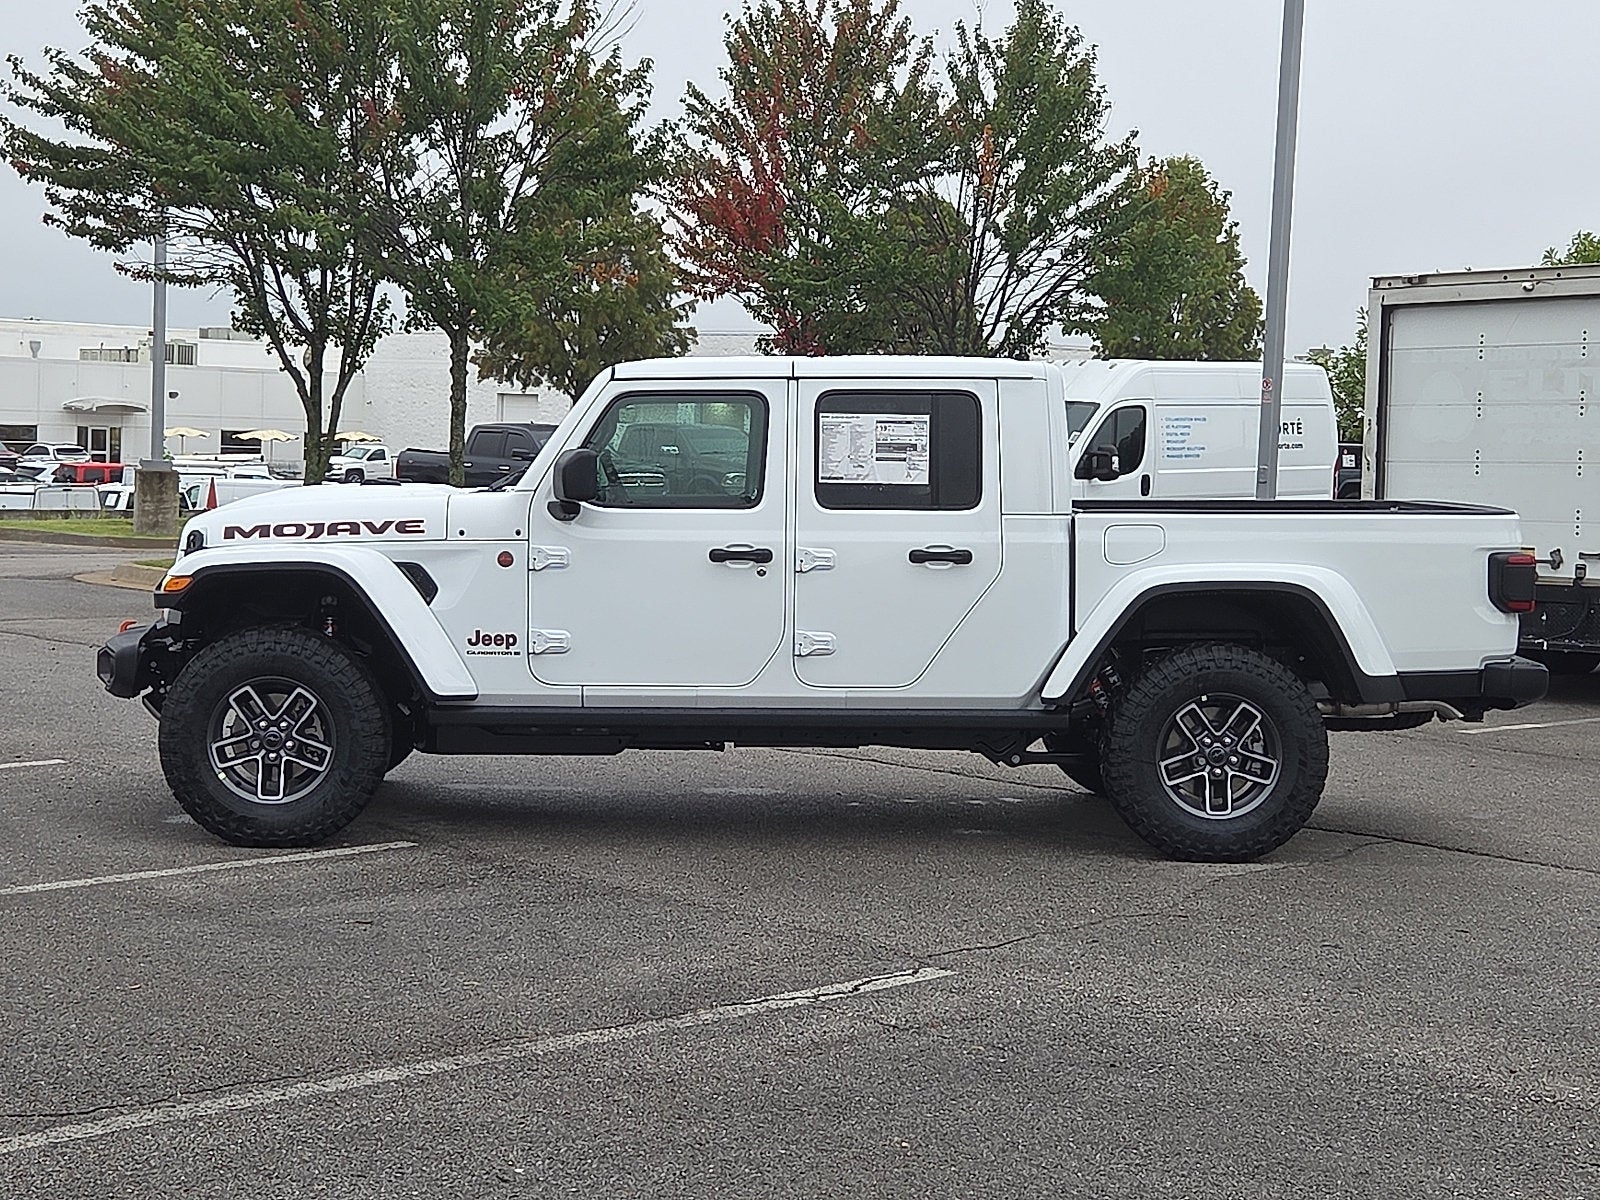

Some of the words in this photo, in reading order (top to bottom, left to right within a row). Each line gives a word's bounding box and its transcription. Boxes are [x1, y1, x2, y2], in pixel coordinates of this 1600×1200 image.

[1279, 417, 1303, 435] RTÉ
[223, 519, 425, 540] MOJAVE
[467, 629, 518, 650] Jeep
